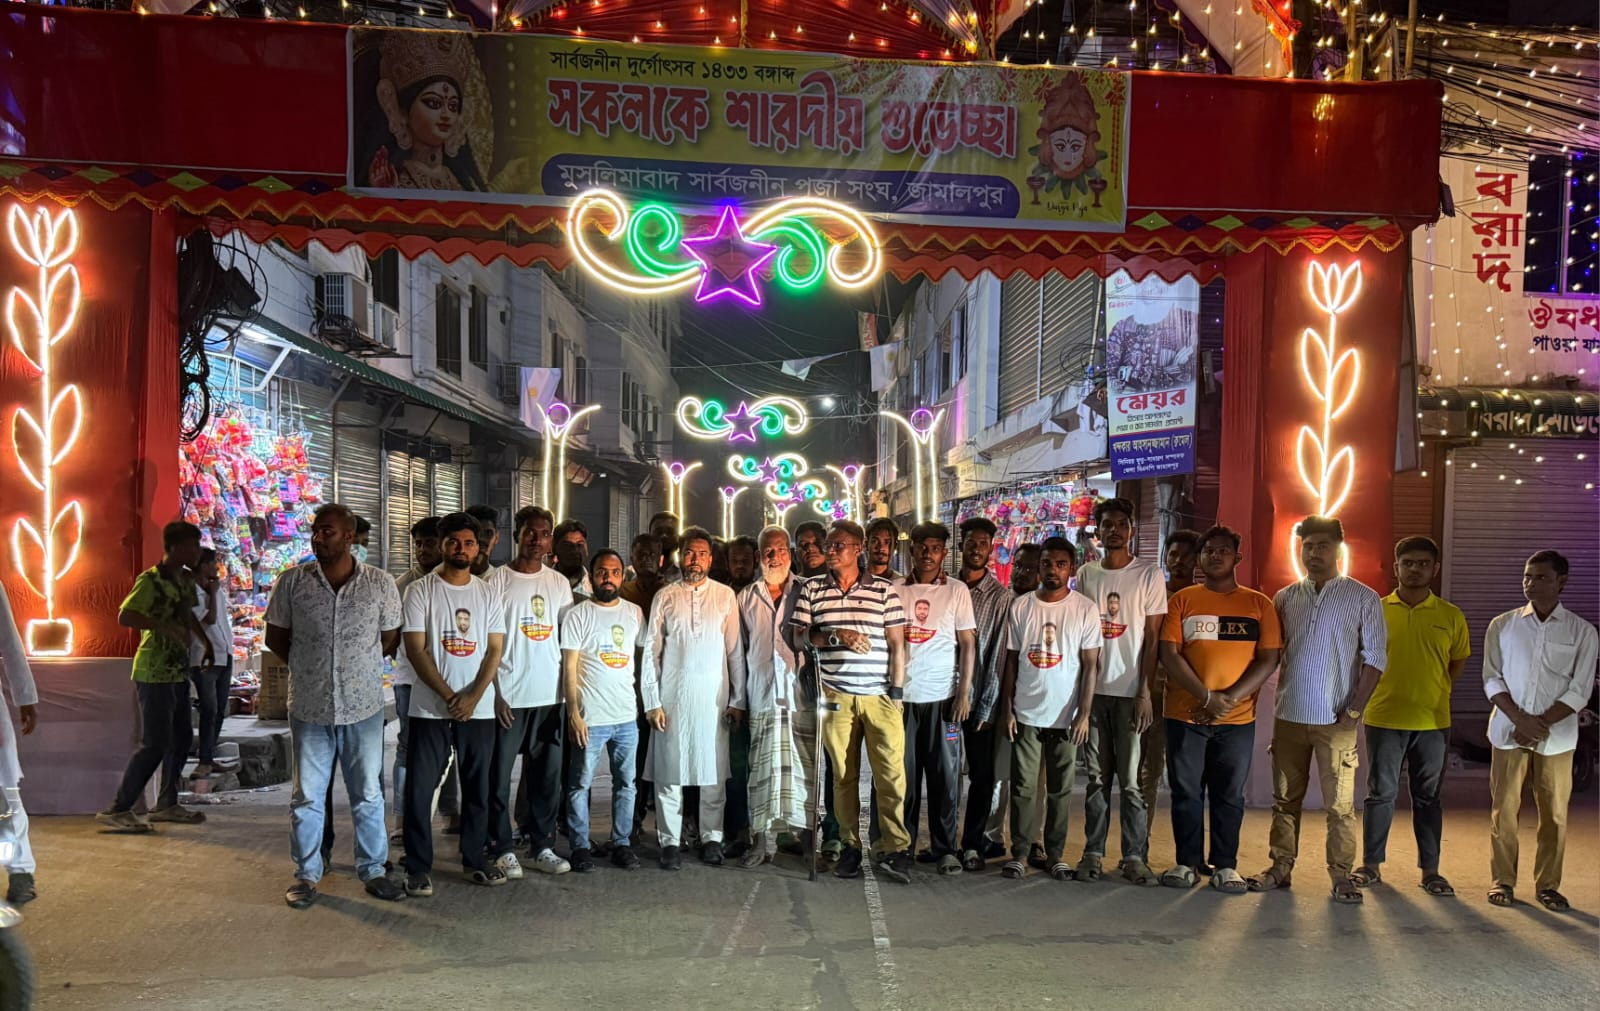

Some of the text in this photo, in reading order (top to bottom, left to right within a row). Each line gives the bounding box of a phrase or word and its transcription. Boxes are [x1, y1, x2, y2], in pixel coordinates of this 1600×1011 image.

[549, 47, 797, 84] সার্বজনীন দুর্গোৎসব ১৪৩৩ বঙ্গাব্দ
[547, 70, 1018, 158] সকলকে শারদীয় শুভেচ্ছা
[557, 160, 683, 190] মুসলিমাবাদ
[687, 167, 789, 197] সার্বজনীন
[795, 177, 841, 198] পজা
[906, 181, 1006, 210] জামালপুর
[1116, 388, 1187, 414] মেয়র
[1194, 621, 1249, 635] ROLEX
